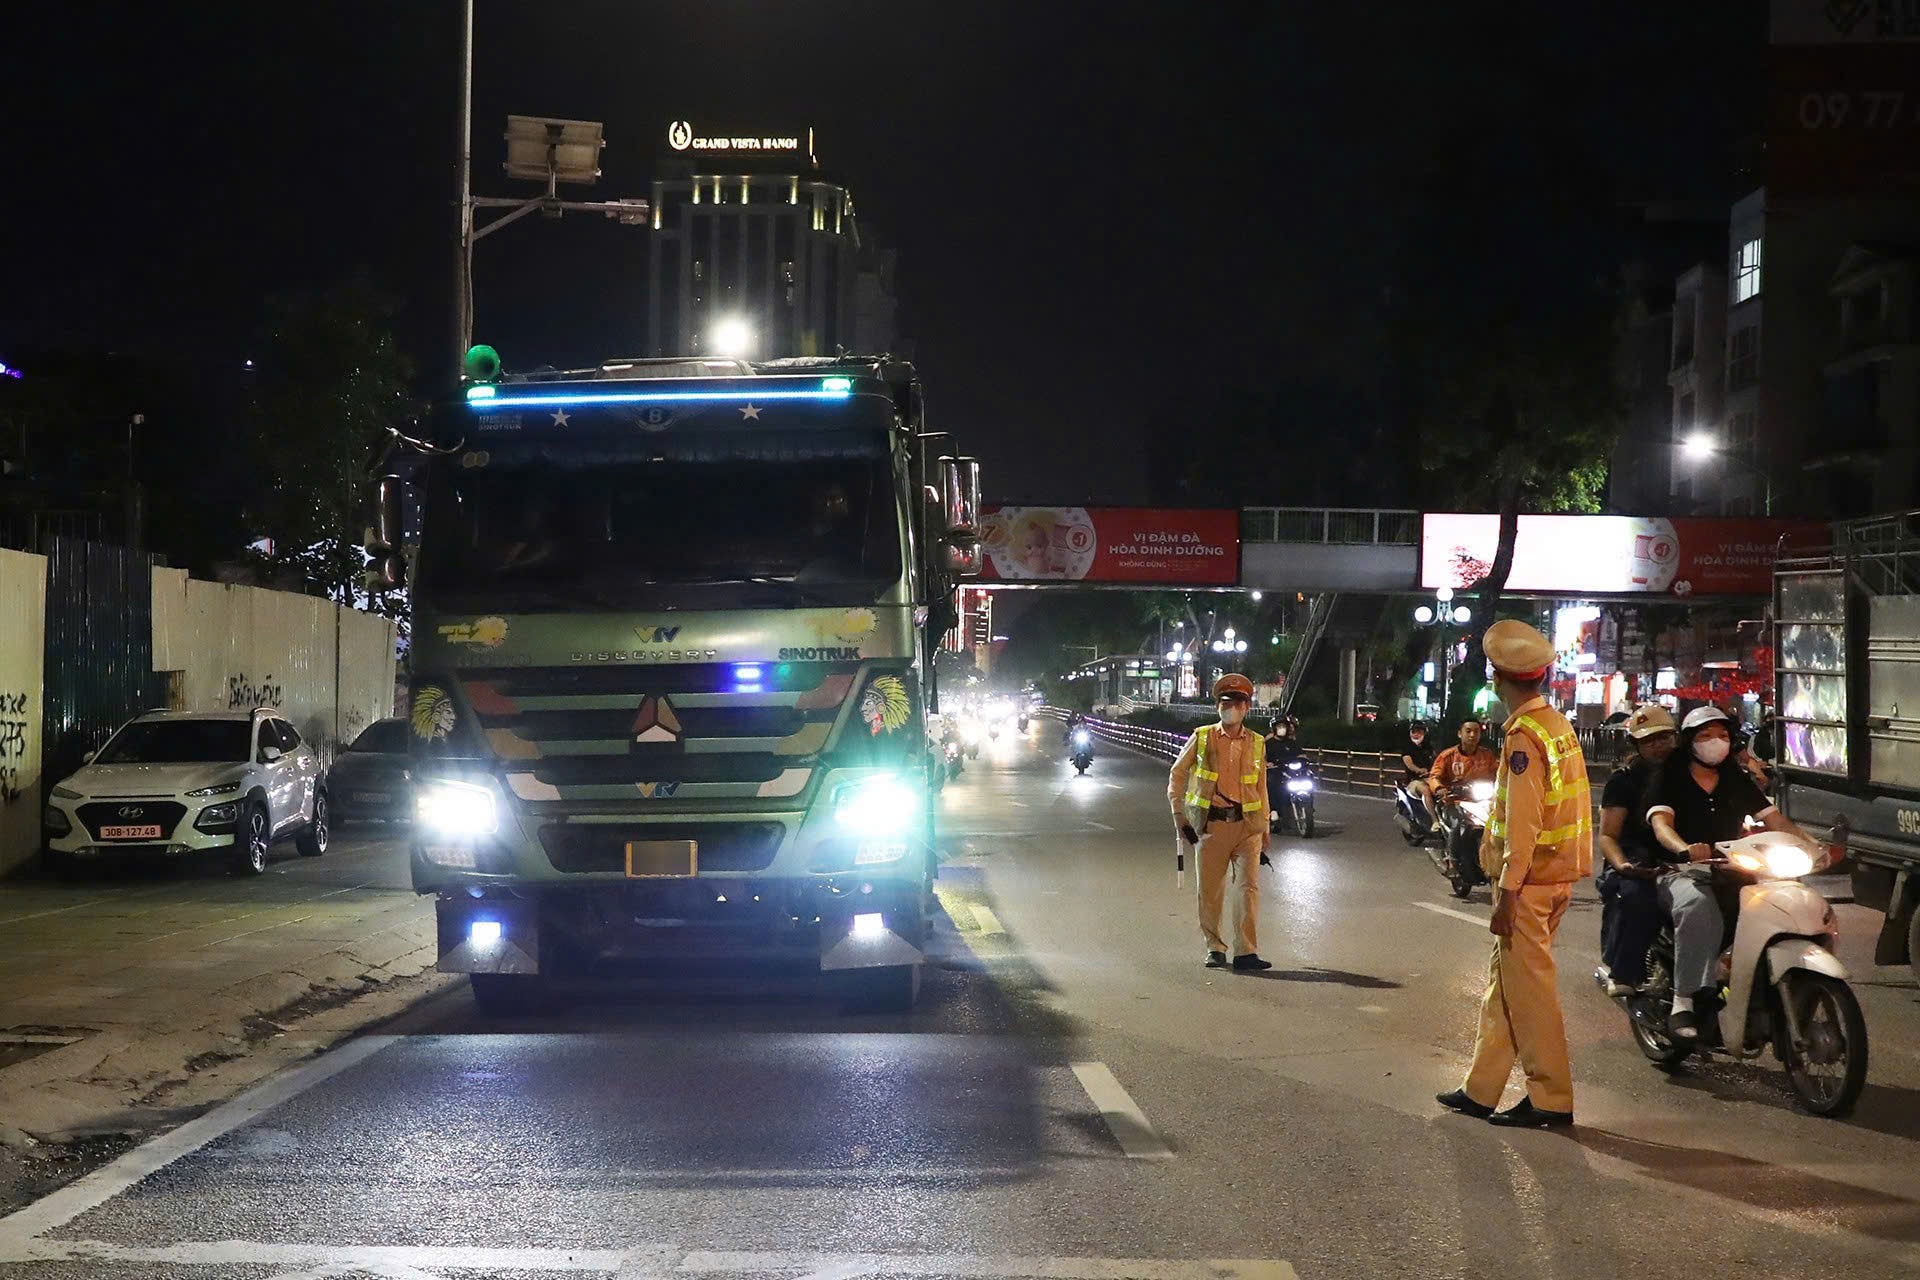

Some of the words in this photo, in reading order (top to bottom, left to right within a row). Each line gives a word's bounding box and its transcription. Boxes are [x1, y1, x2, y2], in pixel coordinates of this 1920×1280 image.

[692, 138, 730, 149] GRAND
[730, 138, 761, 149] VISTA
[762, 138, 798, 149] HANOI
[1133, 532, 1146, 544] VỊ
[1149, 530, 1179, 545] ĐẬM
[1181, 531, 1201, 543] ĐÀ
[1109, 543, 1137, 555] HÒA
[1140, 545, 1172, 555] DINH
[1175, 544, 1225, 556] DƯỠNG
[571, 649, 718, 661] DISCOVERY
[778, 646, 861, 661] SINOTRUK
[105, 827, 156, 837] 30B-127.48
